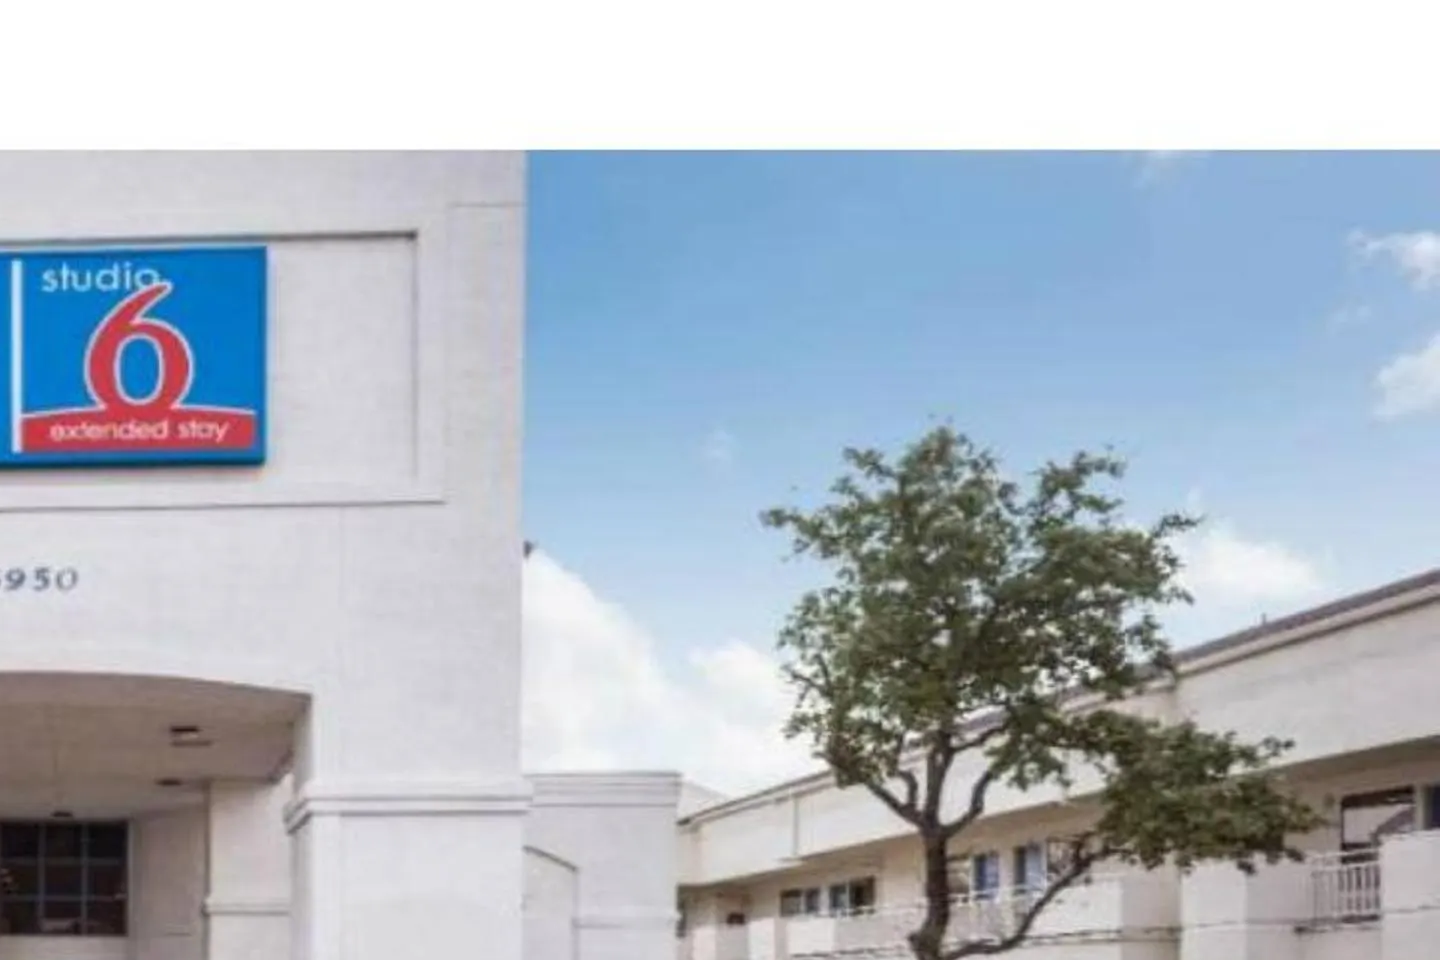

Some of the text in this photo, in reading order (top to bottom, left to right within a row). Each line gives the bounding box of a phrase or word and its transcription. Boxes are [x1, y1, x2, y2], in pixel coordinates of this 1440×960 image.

[41, 262, 162, 292] studio
[83, 280, 195, 412] 6
[49, 418, 230, 443] extended stay
